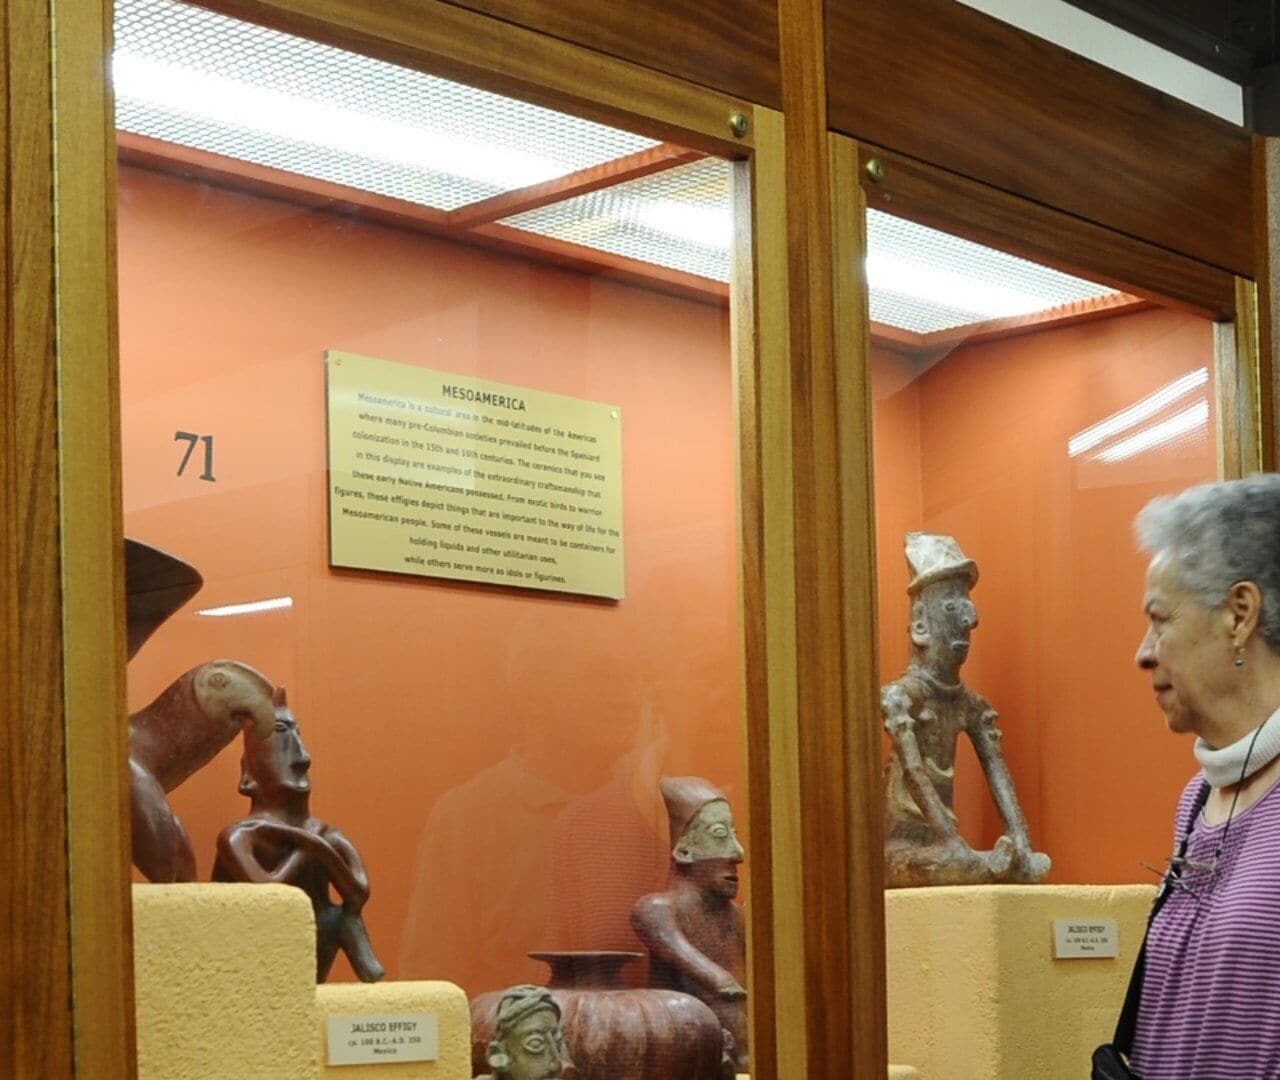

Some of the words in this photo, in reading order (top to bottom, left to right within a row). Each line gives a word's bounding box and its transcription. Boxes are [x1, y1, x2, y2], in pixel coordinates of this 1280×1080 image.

[442, 385, 526, 411] MESOAMERICA
[174, 430, 217, 482] 71
[350, 1023, 386, 1034] JALISCO
[389, 1021, 417, 1032] EFFIGY
